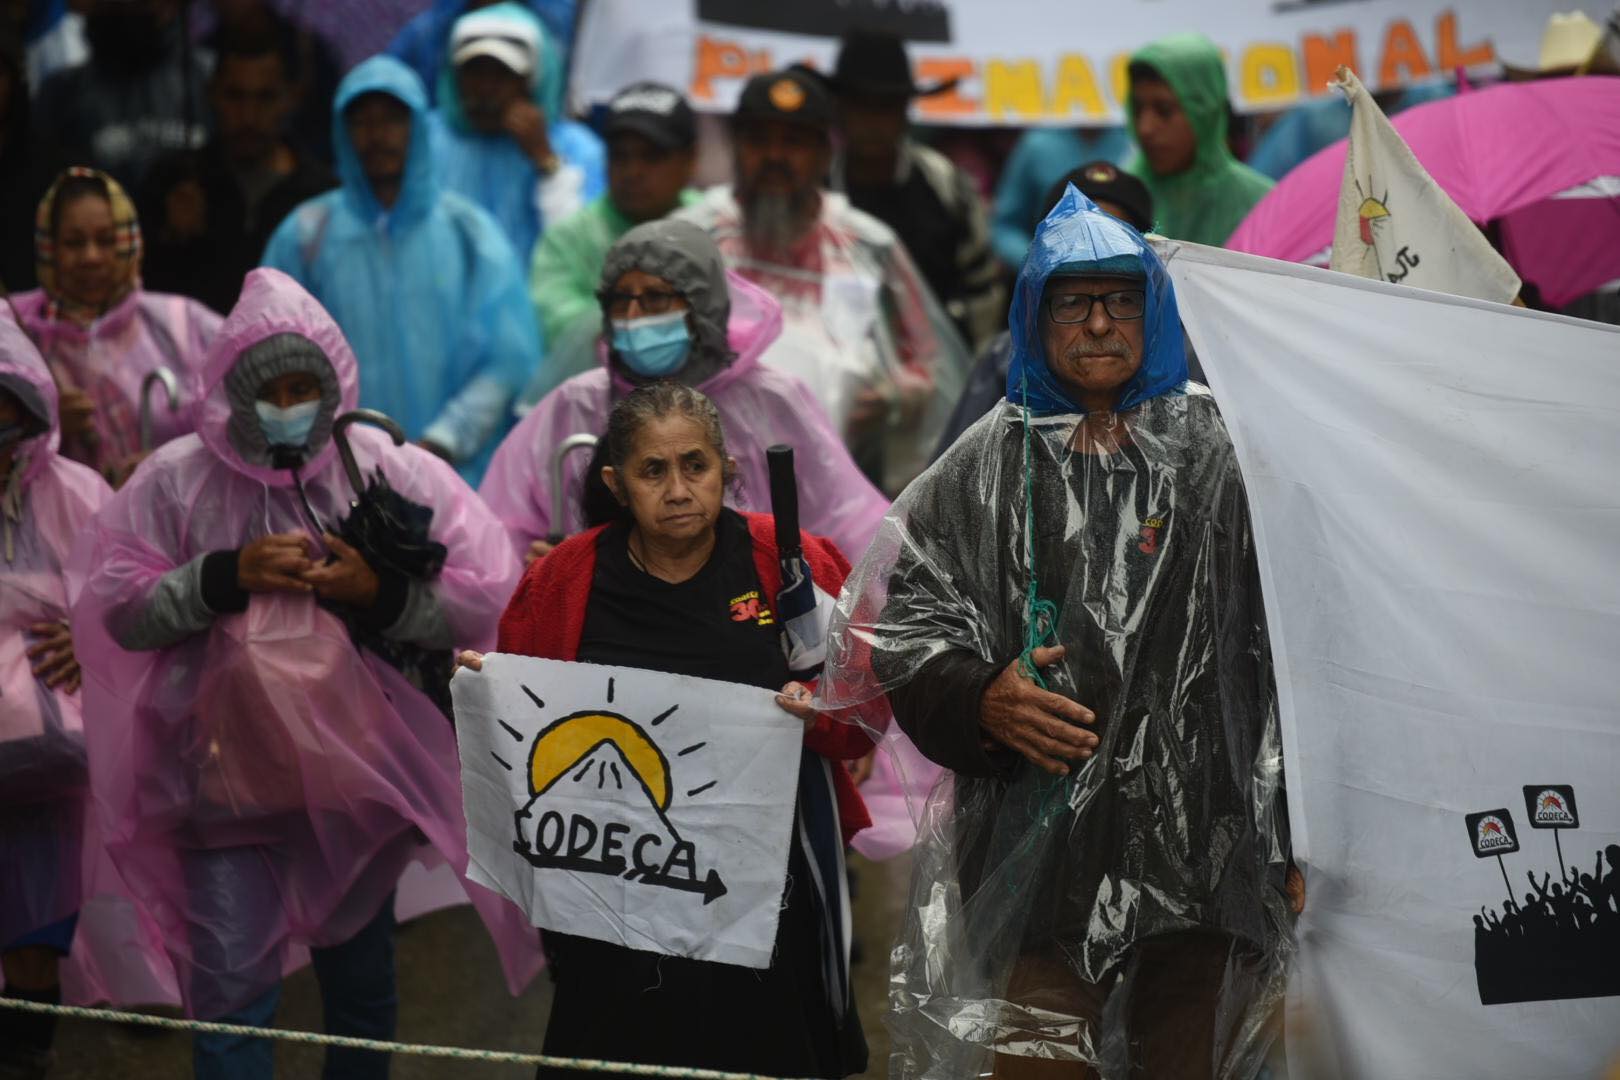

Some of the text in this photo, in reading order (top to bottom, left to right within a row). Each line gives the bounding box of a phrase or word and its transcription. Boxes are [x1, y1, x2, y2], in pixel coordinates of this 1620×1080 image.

[1537, 811, 1570, 821] CODECA
[514, 808, 697, 881] CODECA
[1480, 836, 1510, 849] CODECA
